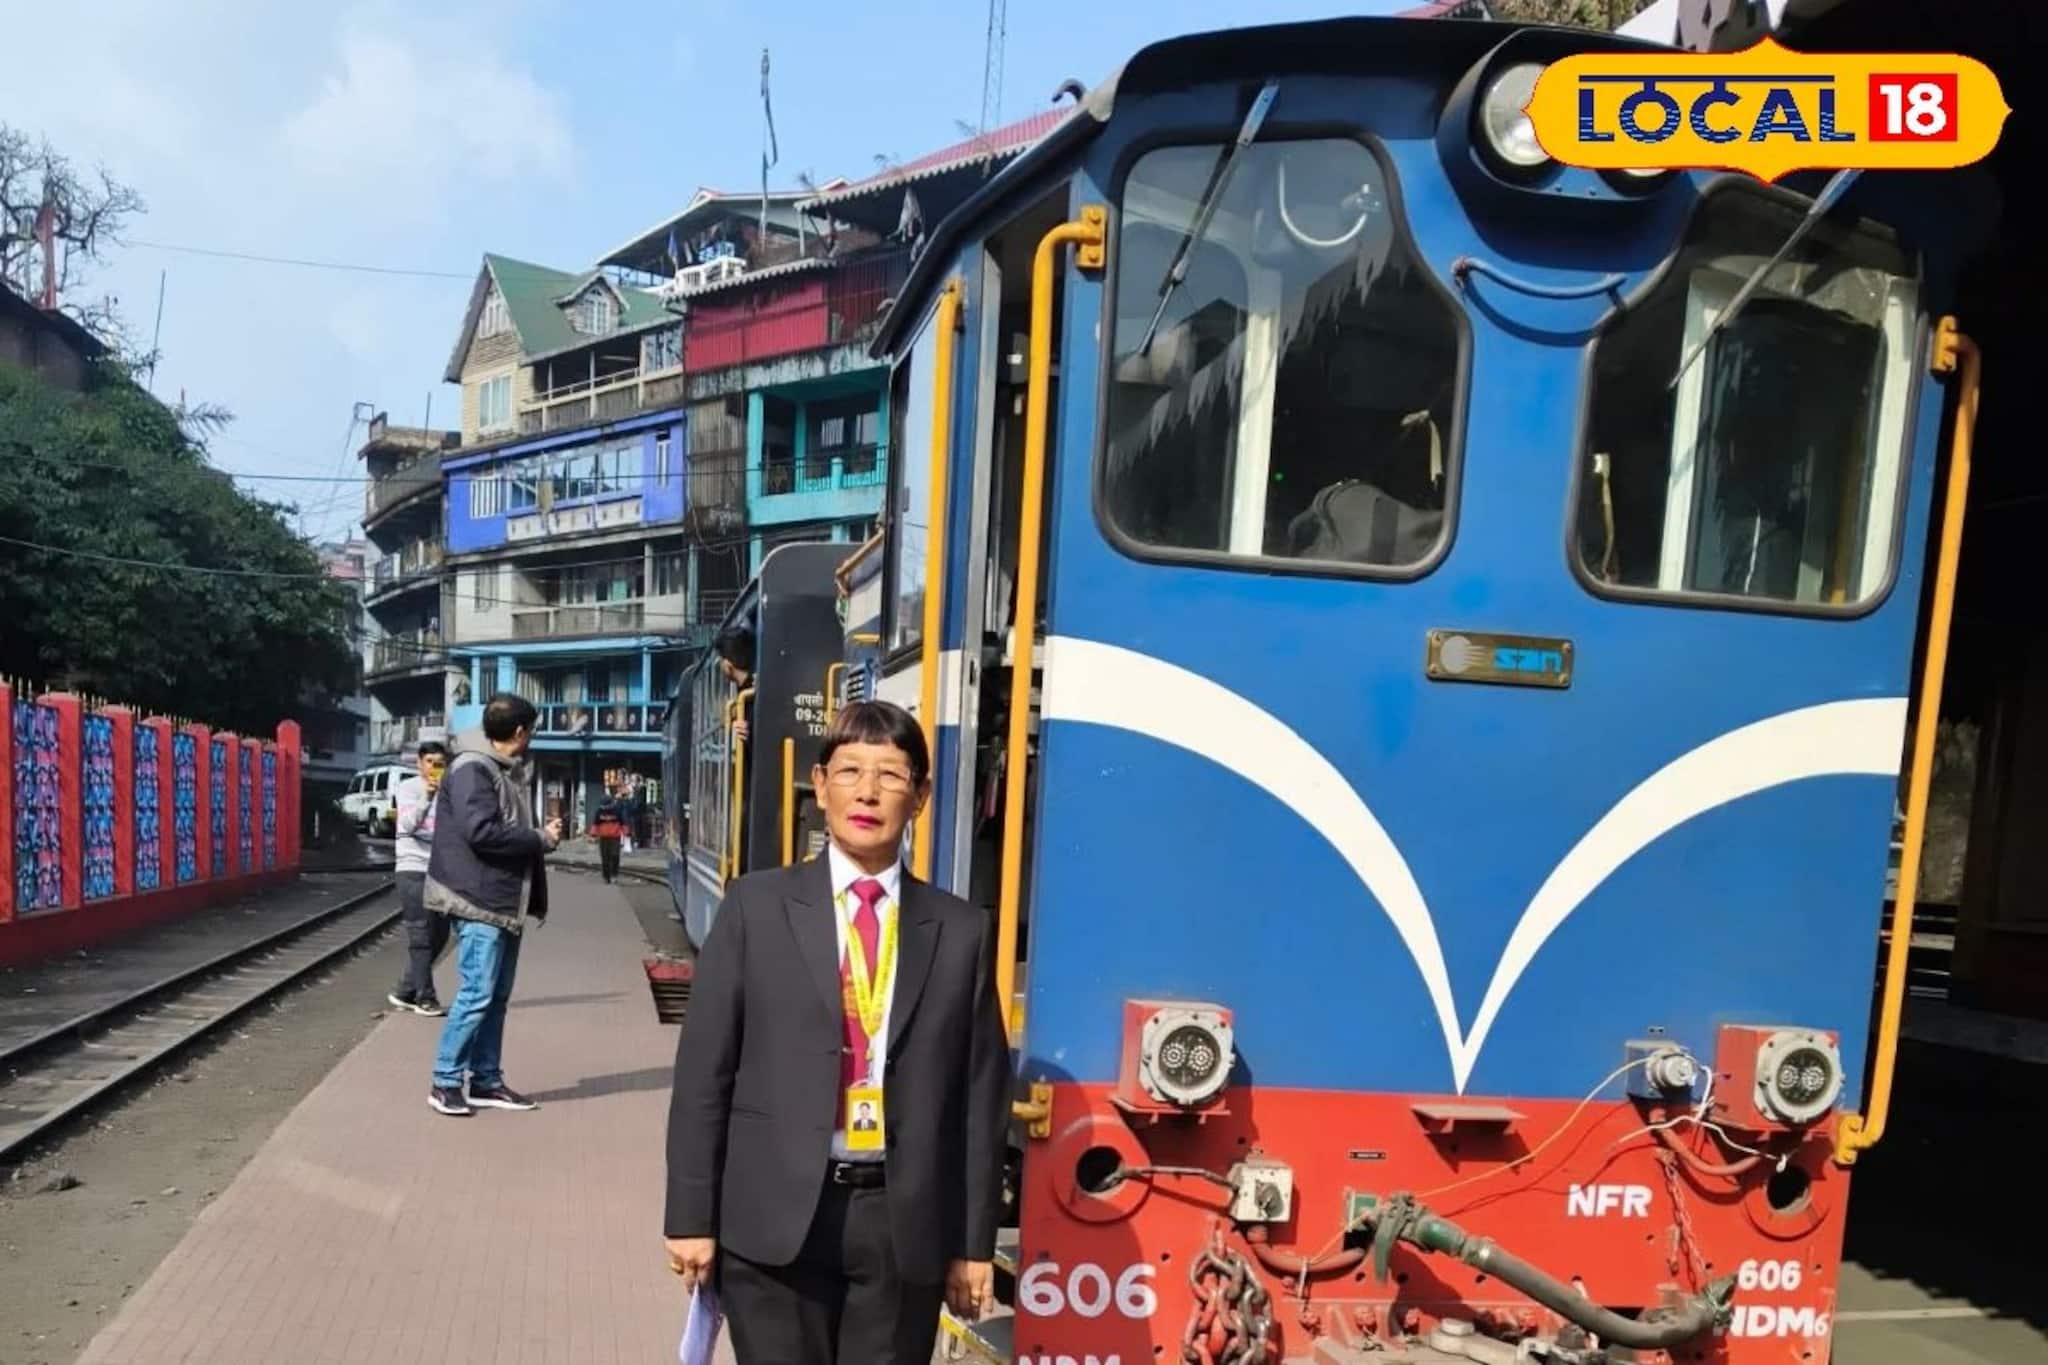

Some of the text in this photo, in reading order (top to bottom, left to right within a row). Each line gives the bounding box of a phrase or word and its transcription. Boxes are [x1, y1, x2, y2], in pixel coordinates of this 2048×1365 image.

[1567, 1184, 1653, 1218] NFR
[1018, 1261, 1158, 1318] 606
[1738, 1258, 1802, 1291] 606
